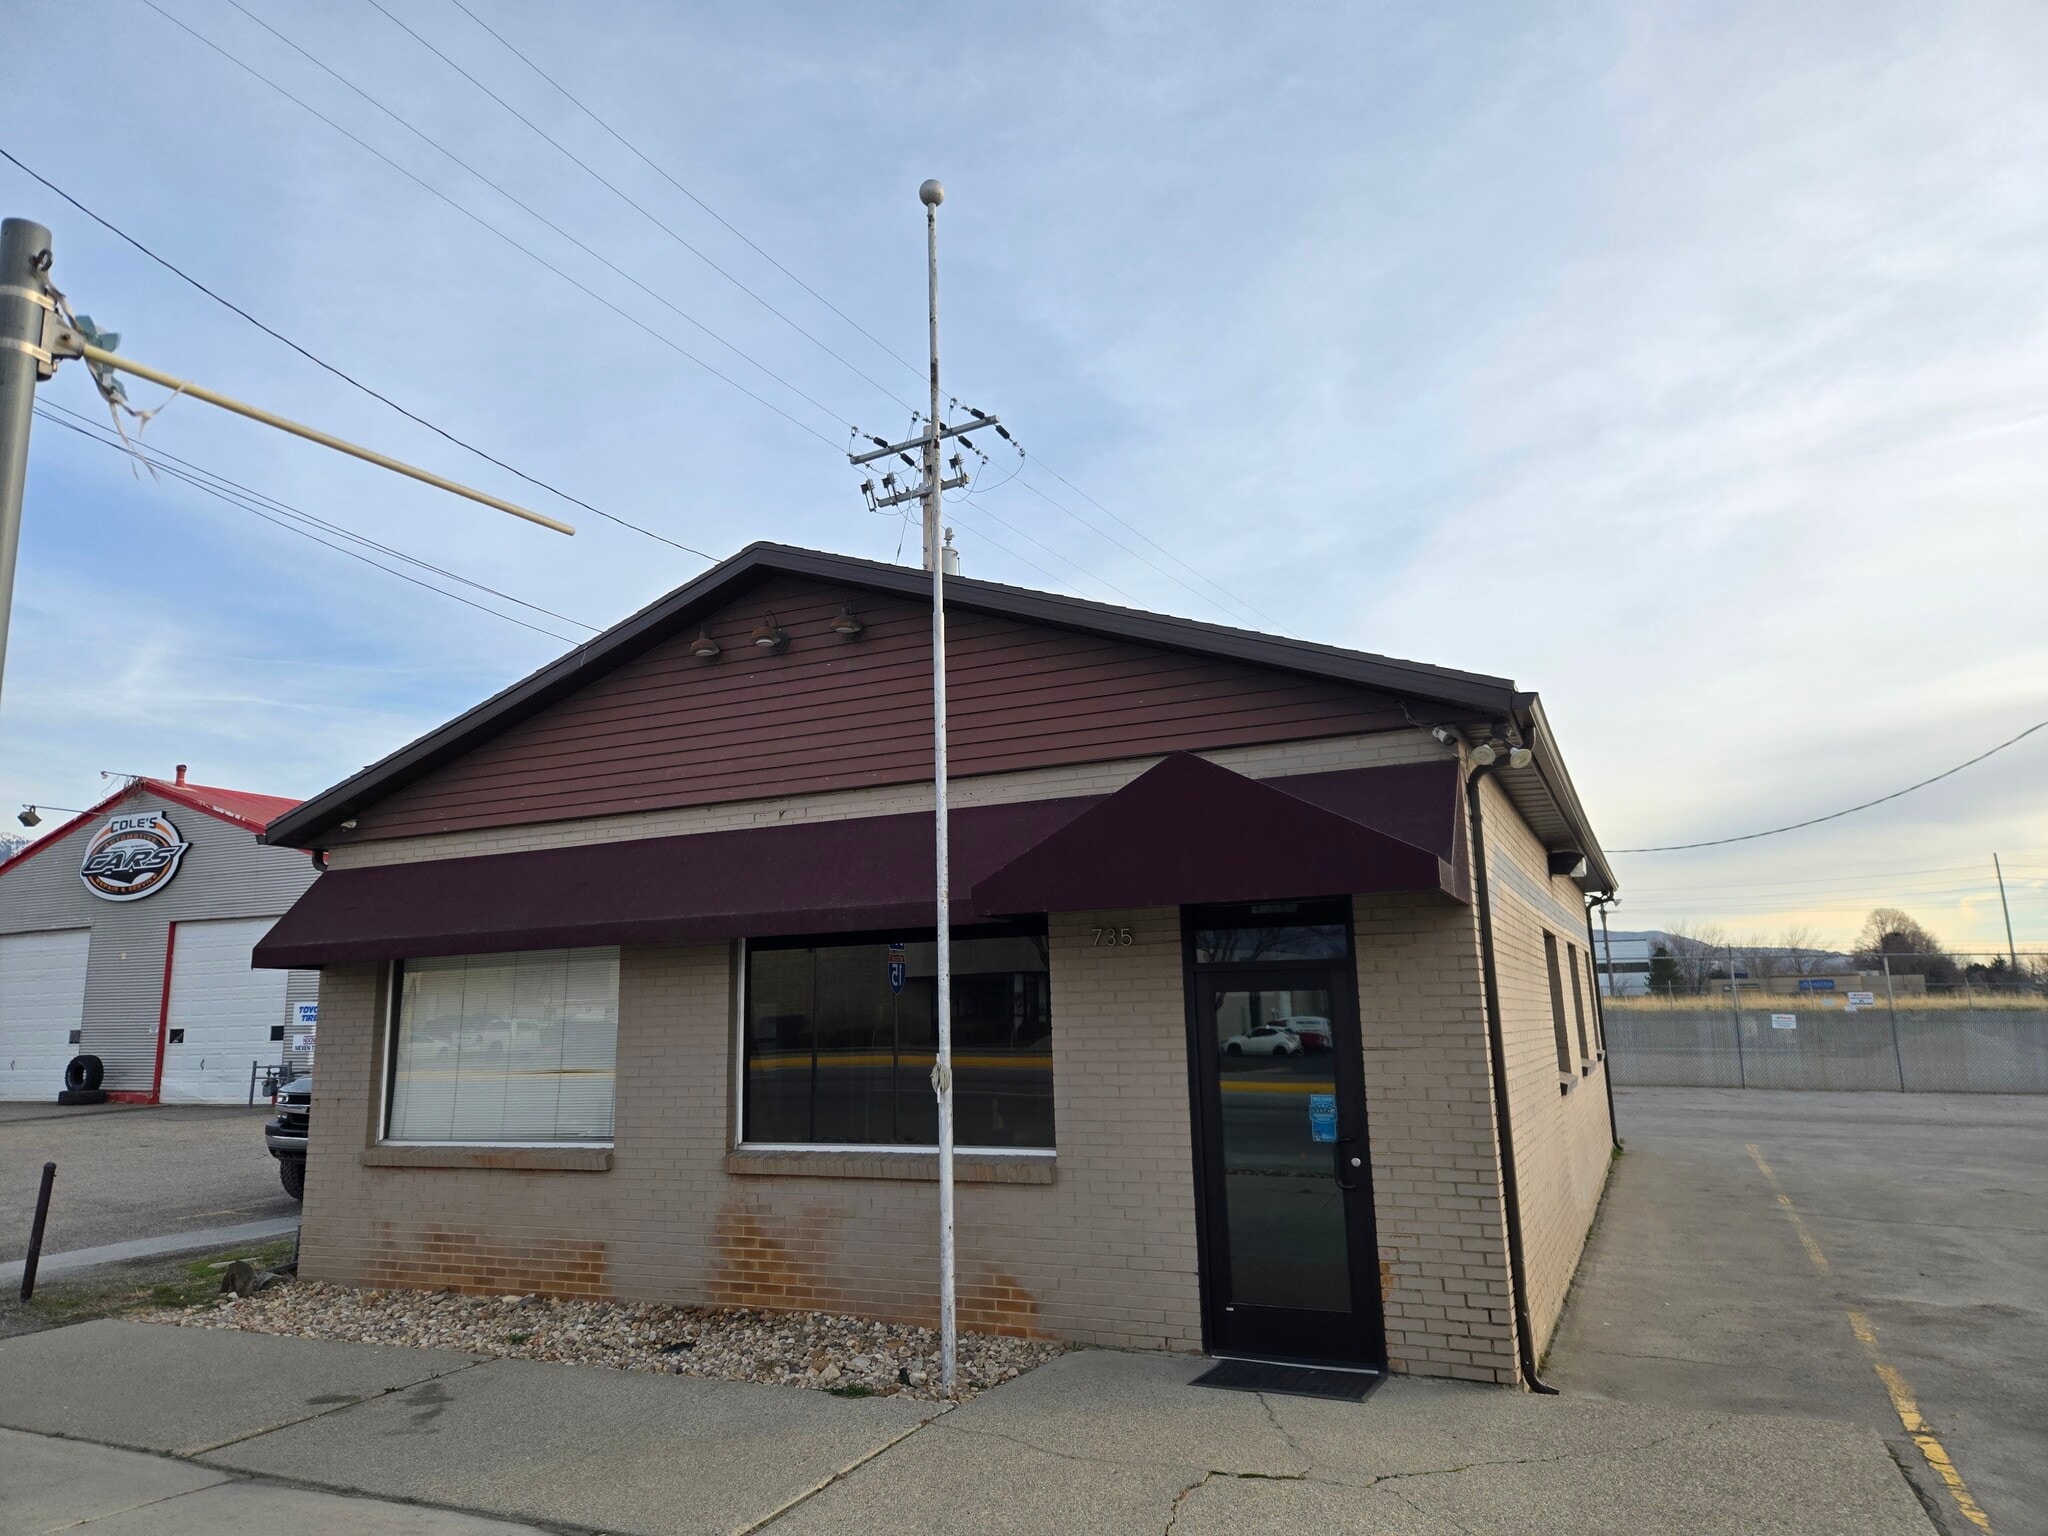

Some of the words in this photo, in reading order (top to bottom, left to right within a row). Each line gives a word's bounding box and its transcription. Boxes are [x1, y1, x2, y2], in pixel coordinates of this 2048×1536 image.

[111, 817, 158, 833] COLE'S
[104, 833, 159, 848] AUTOMOTIVE
[83, 846, 181, 872] CARS
[95, 878, 119, 892] REPAIR
[128, 873, 158, 892] SERVICE
[1091, 928, 1132, 946] 735
